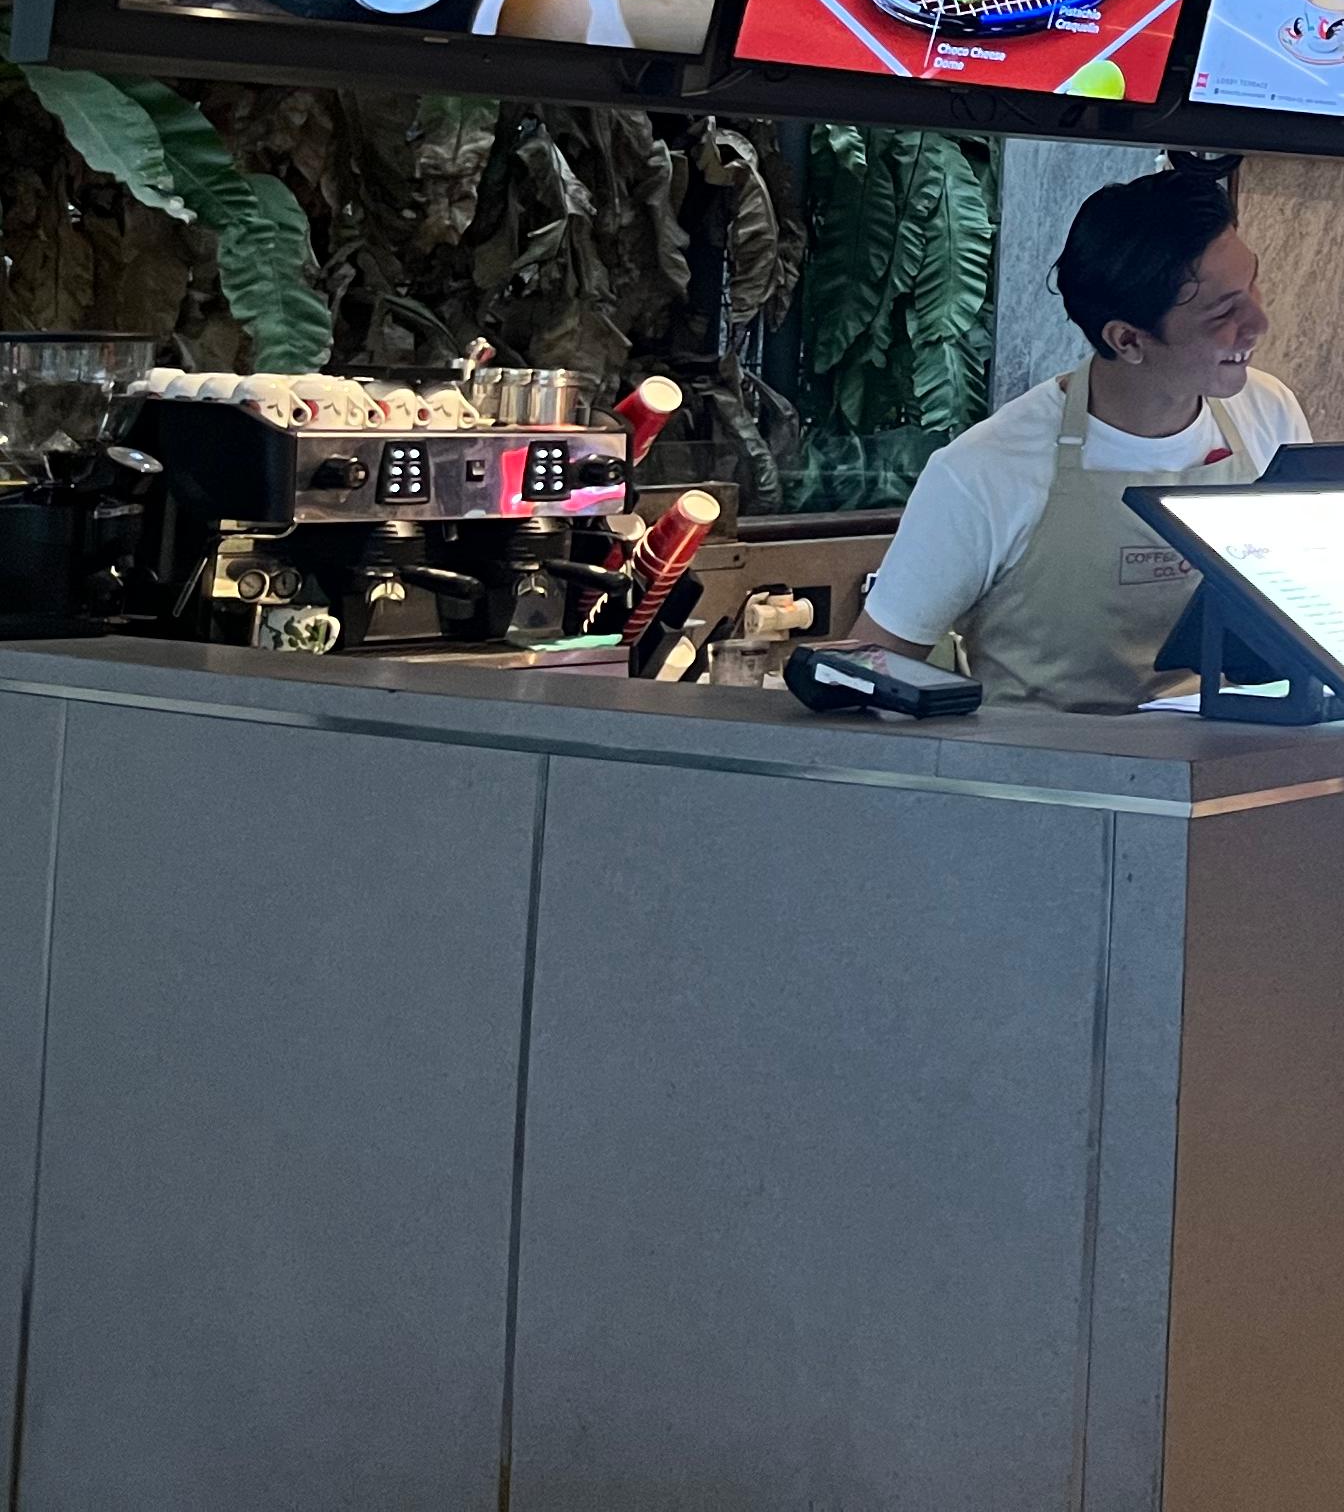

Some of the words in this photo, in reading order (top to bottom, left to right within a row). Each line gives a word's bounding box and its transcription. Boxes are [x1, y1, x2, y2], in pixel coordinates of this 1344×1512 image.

[1058, 5, 1102, 21] Pistachio
[937, 43, 969, 57] Choco
[970, 47, 1007, 62] Cheese
[933, 56, 965, 71] Dome
